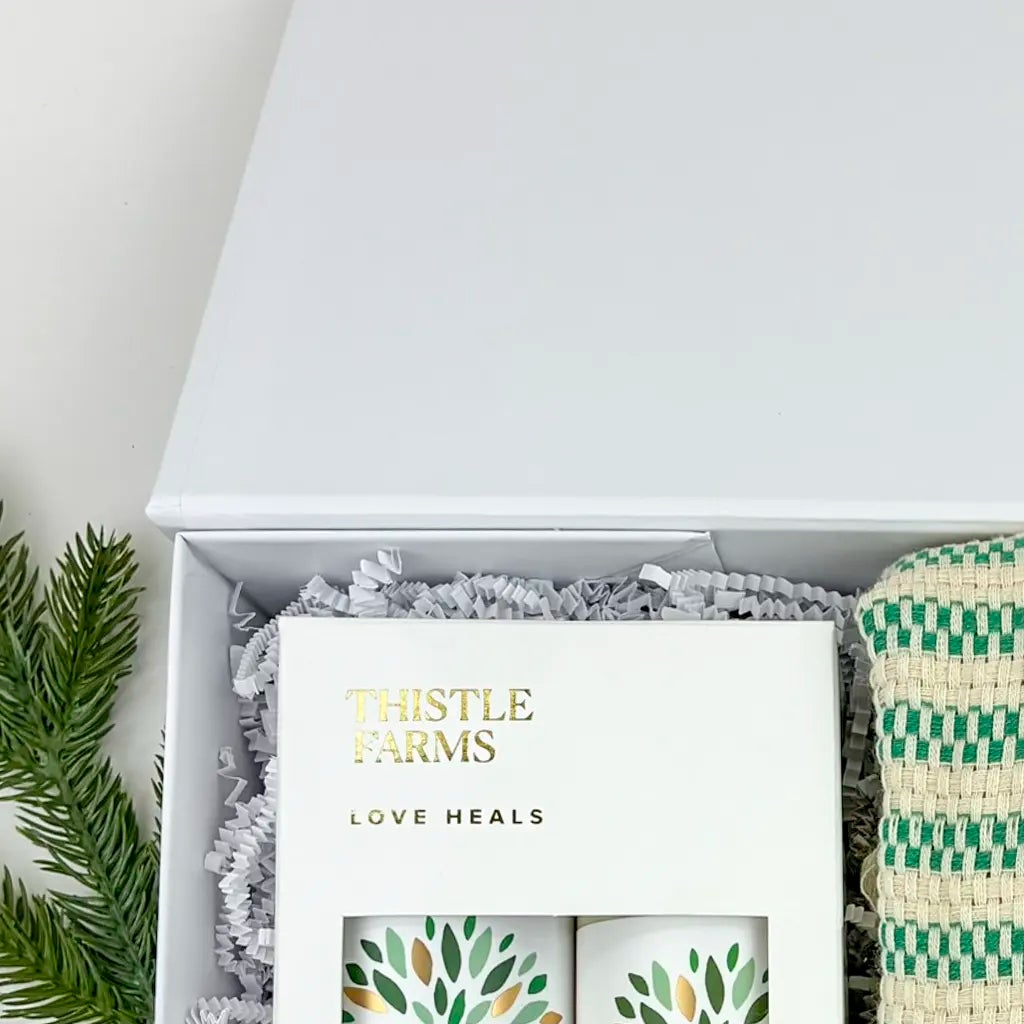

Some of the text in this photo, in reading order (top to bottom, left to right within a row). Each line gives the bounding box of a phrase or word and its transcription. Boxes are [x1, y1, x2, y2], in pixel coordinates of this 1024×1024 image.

[345, 688, 534, 722] THISTLE
[354, 729, 496, 763] FARMS
[350, 808, 544, 825] LOVE HEALS
